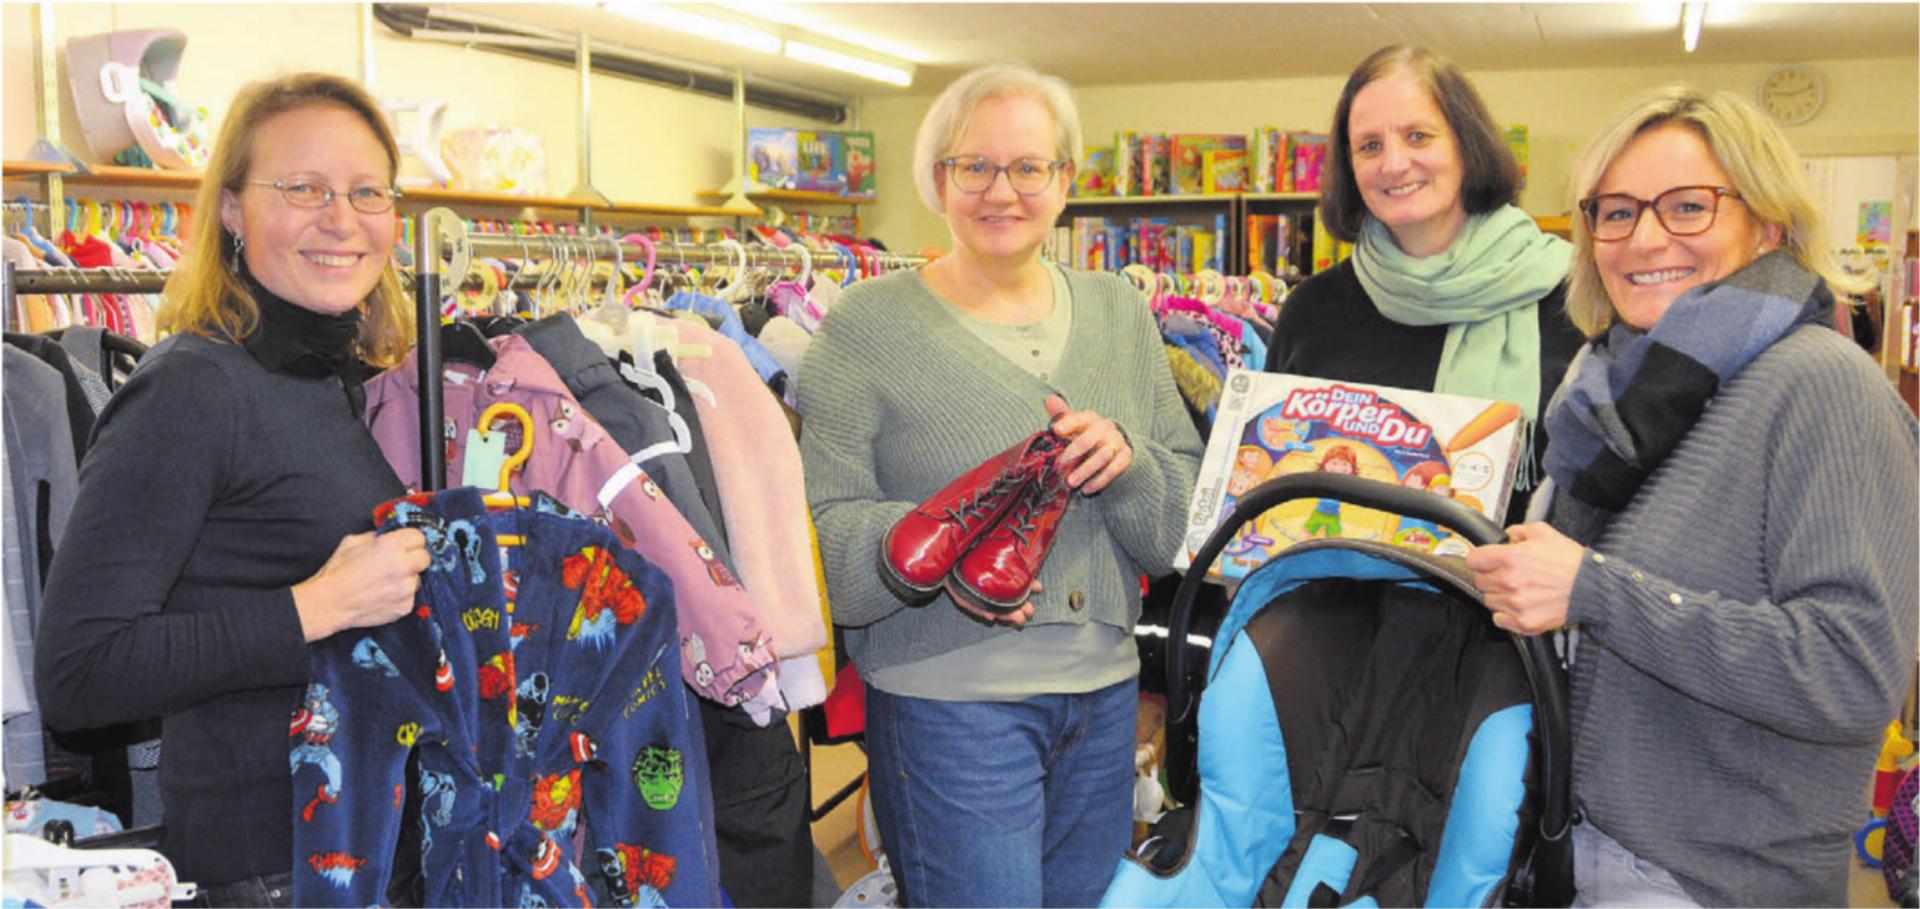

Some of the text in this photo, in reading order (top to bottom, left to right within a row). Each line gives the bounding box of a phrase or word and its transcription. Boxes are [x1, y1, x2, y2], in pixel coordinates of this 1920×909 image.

[1331, 388, 1374, 404] DEIN
[1285, 391, 1396, 426] Körper
[1343, 419, 1380, 434] UND
[1377, 418, 1427, 444] Du
